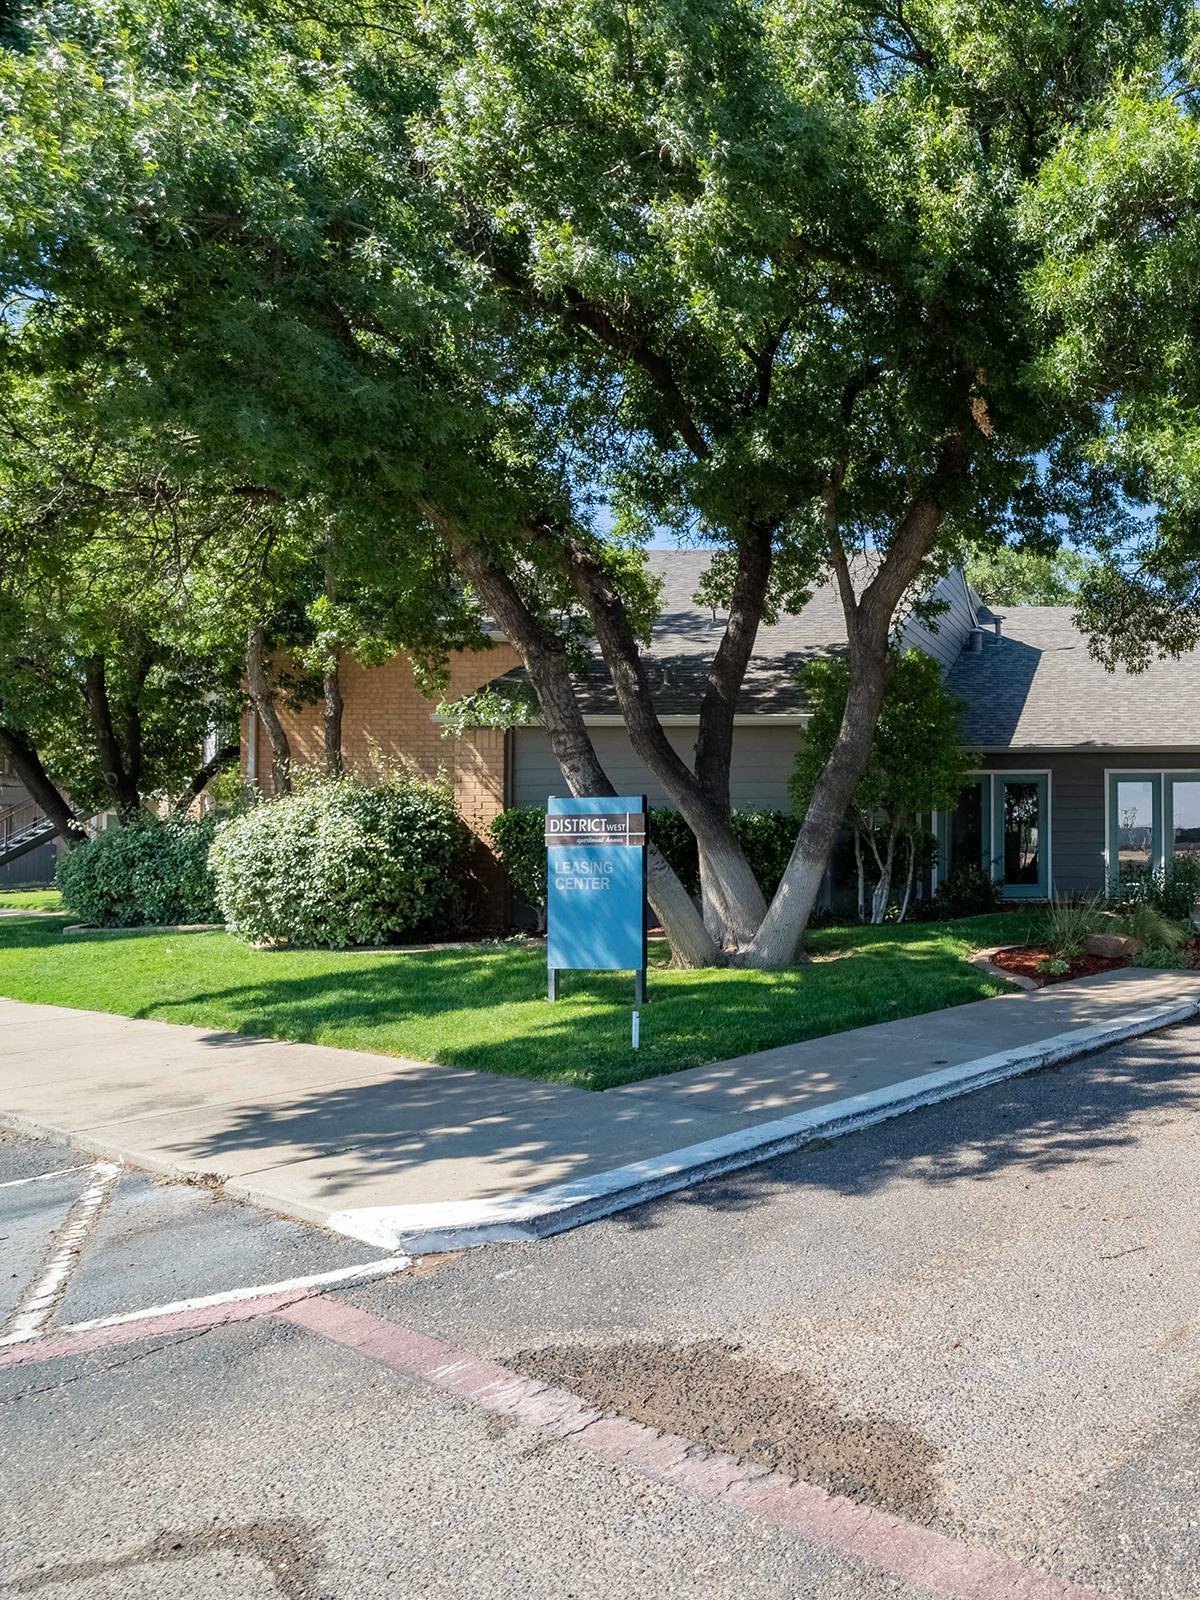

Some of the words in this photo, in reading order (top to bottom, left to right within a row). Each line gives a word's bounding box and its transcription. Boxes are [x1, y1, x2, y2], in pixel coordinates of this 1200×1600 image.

[550, 819, 607, 832] DISTRICT
[606, 823, 626, 832] WEST
[554, 860, 614, 874] LEASING
[554, 877, 610, 890] CENTER
